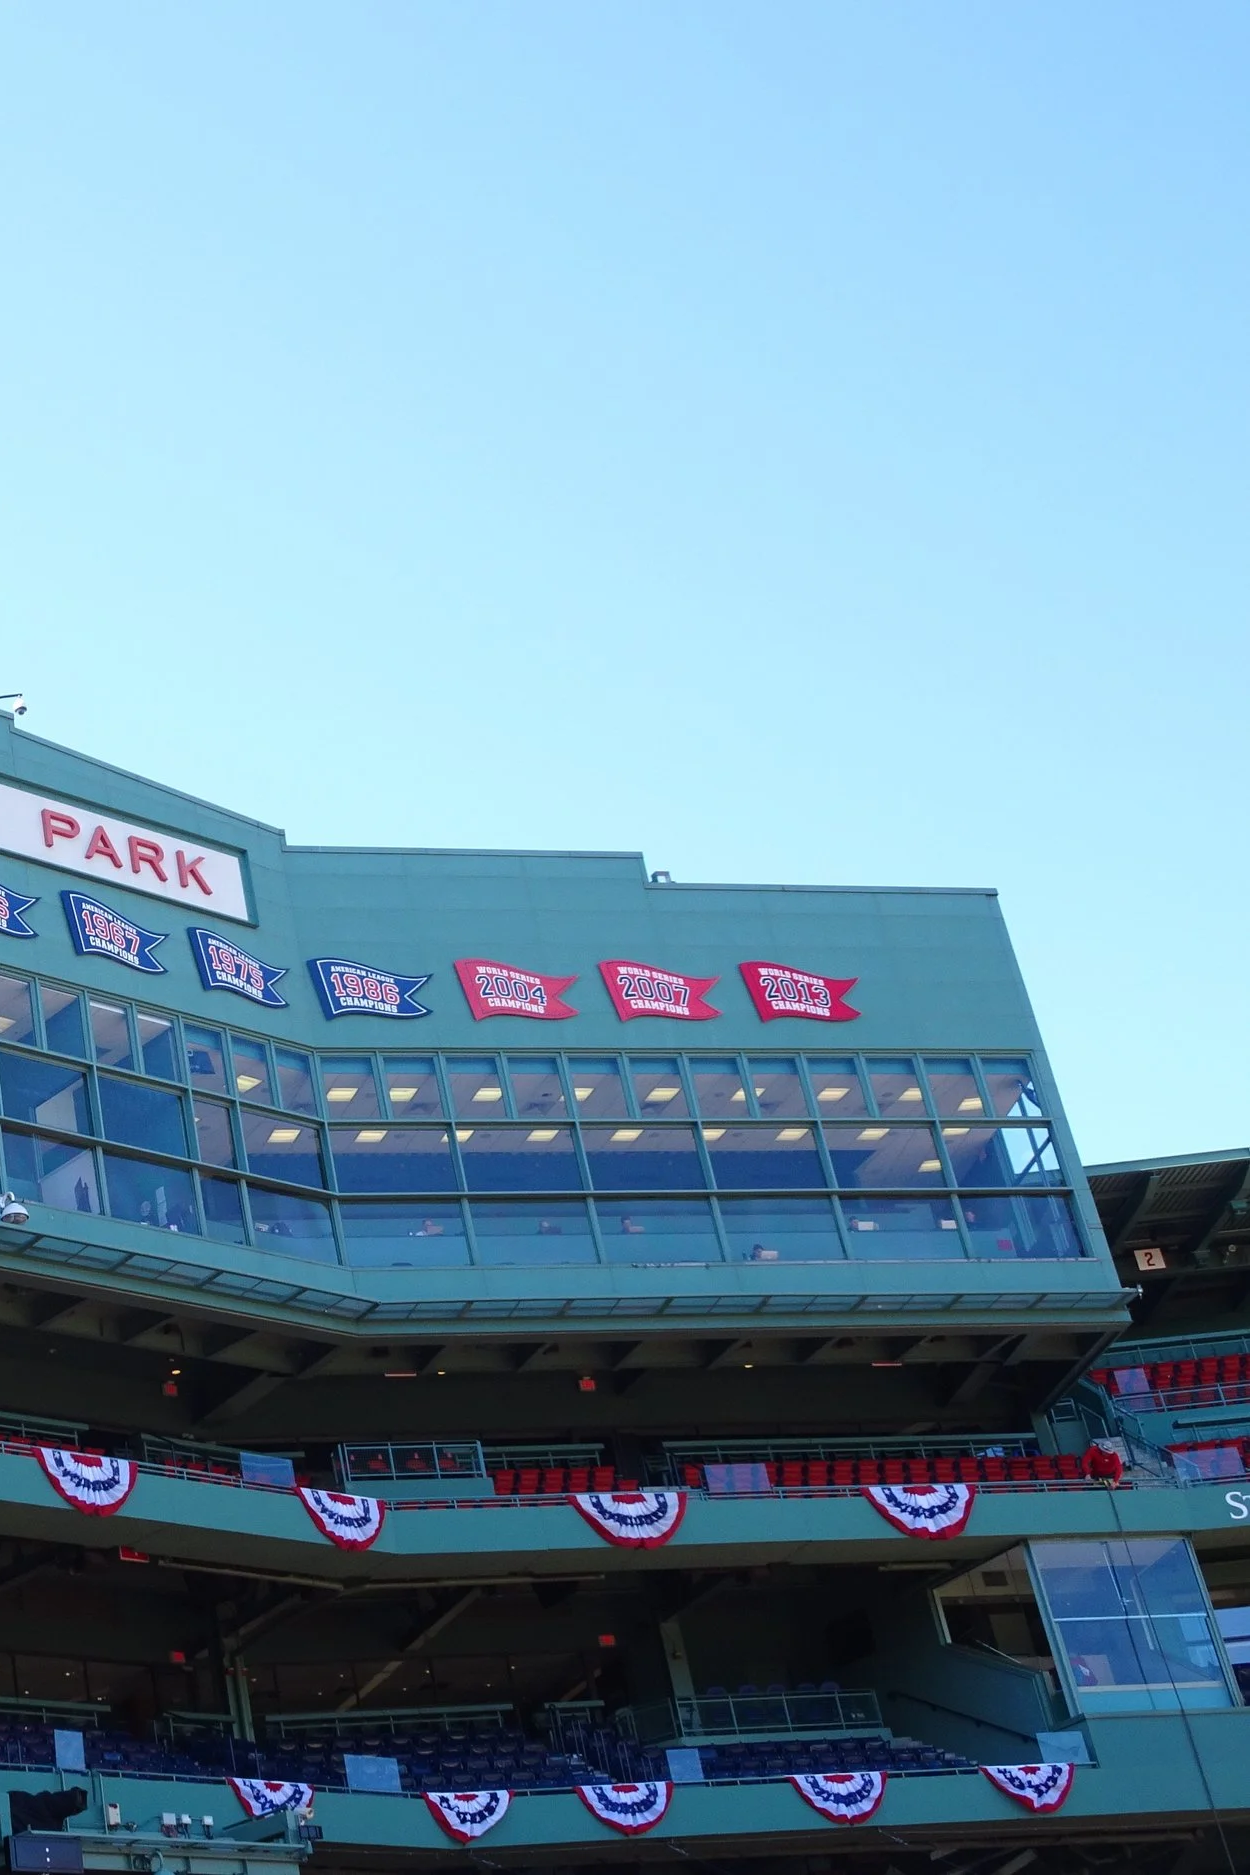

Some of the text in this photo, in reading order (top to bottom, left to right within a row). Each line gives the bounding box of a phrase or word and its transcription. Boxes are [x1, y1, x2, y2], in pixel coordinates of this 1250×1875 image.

[41, 808, 213, 895] PARK
[81, 902, 137, 935] AMERICAN LEAGUE
[81, 910, 140, 954] 1967
[89, 935, 139, 965] CHAMPIONS
[208, 937, 260, 969] AMERICAN LEAGUE
[208, 945, 264, 991] 1975
[331, 966, 394, 983] AMERICAN LEAGUE
[476, 966, 541, 985] WORLD SERIES
[617, 966, 684, 985] WORLD SERIES
[758, 967, 824, 986] WORLD SERIES
[216, 970, 263, 999] CHAMPIONS
[331, 972, 400, 1004] 1986
[476, 975, 547, 1006] 2004
[618, 976, 690, 1007] 2007
[760, 977, 831, 1008] 2013
[340, 997, 397, 1013] CHAMPIONS
[488, 998, 545, 1014] CHAMPIONS
[630, 1000, 690, 1016] CHAMPIONS
[771, 1001, 830, 1017] CHAMPIONS
[1144, 1251, 1156, 1267] 2
